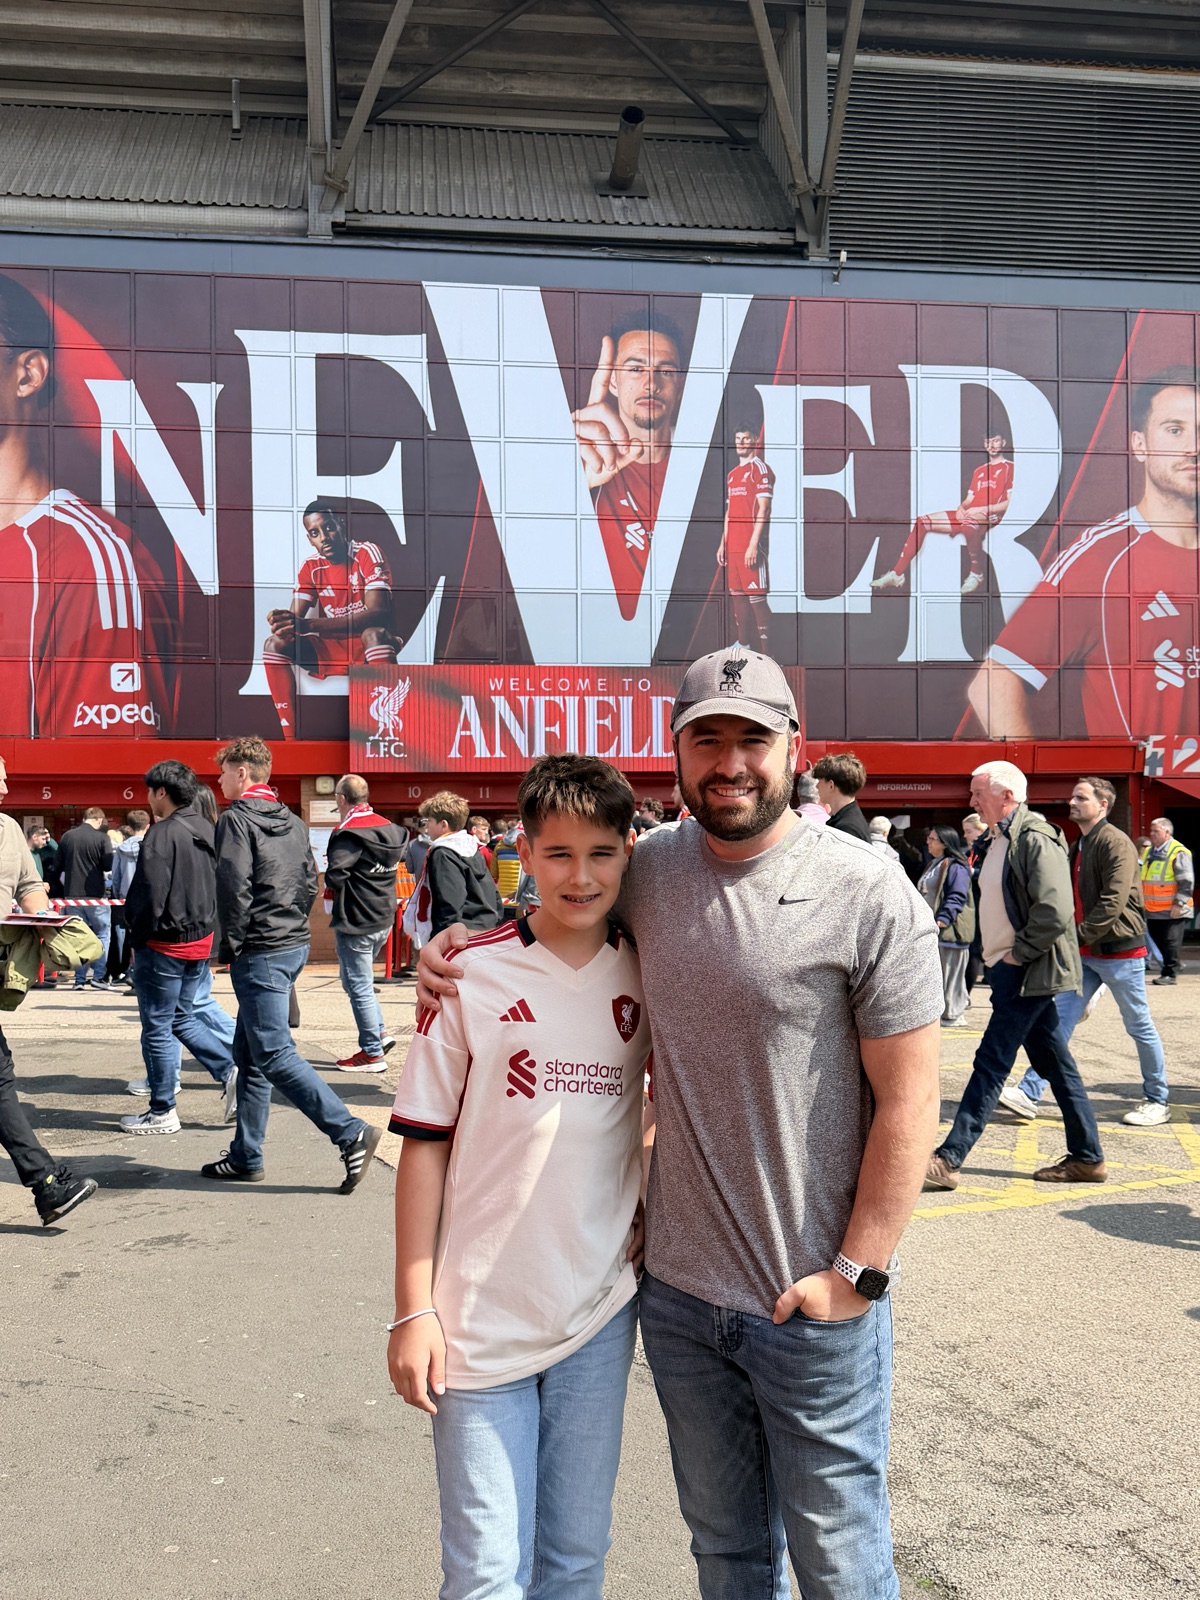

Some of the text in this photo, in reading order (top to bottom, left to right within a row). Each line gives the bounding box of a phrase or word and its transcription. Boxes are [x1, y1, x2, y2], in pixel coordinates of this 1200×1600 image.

[85, 281, 1063, 695] NEVER
[489, 678, 651, 692] WELCOME TO
[448, 696, 677, 758] ANFIELD
[42, 786, 52, 800] 5
[123, 786, 134, 800] 6
[408, 786, 421, 798] 10
[480, 787, 490, 798] 11
[877, 783, 932, 791] INFORMATION
[545, 1059, 624, 1080] standard
[543, 1076, 623, 1097] chartered
